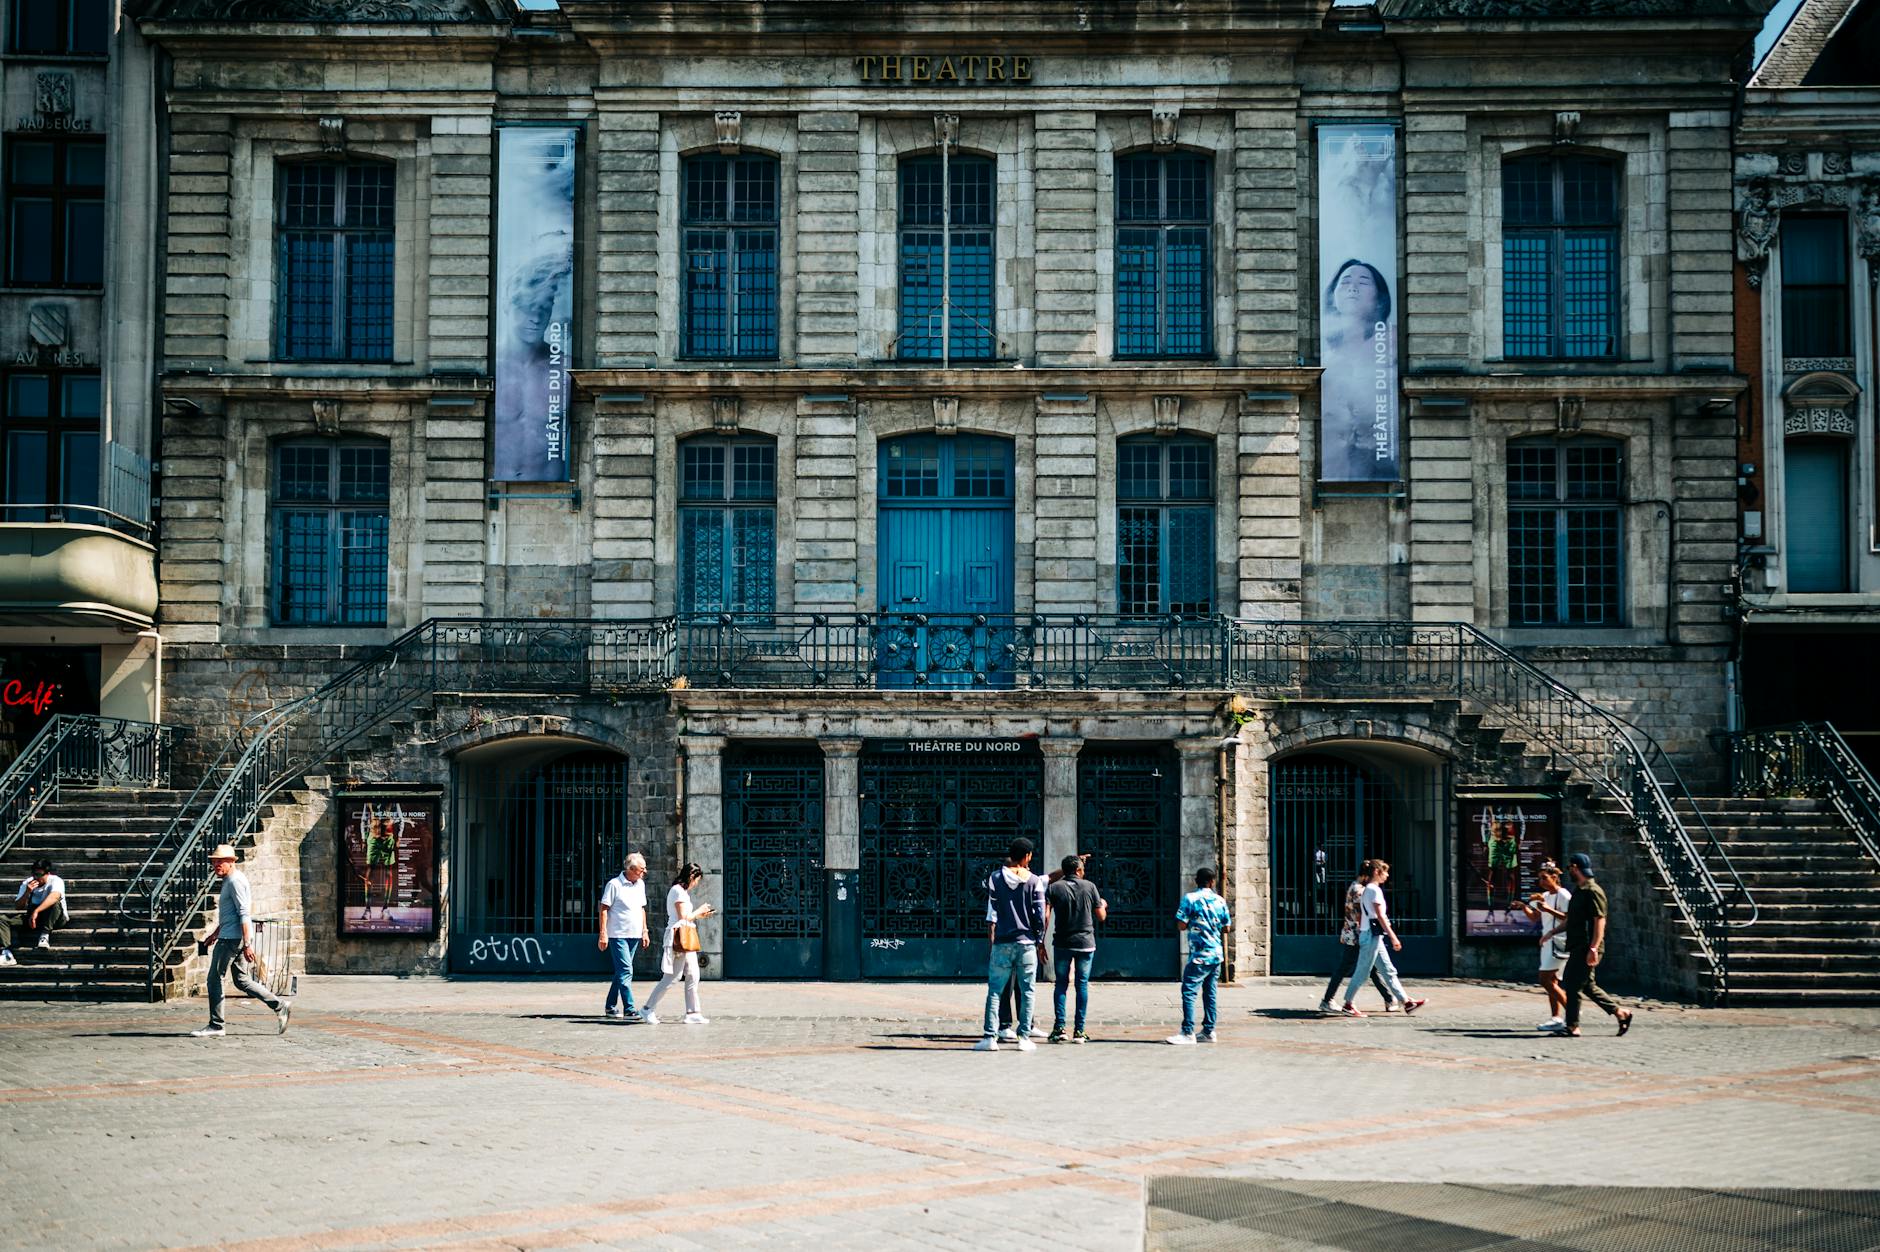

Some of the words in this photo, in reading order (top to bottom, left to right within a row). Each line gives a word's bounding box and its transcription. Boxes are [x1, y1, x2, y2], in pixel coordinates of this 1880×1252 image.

[855, 55, 1032, 80] THEATRE
[16, 118, 91, 130] MAUBEUGE
[549, 321, 562, 365] NORD
[1375, 320, 1387, 364] NORD
[16, 351, 81, 365] AVNES
[549, 369, 561, 390] DU
[1375, 369, 1387, 389] DU
[545, 394, 560, 461] THÉÂTRE
[1373, 394, 1388, 461] THÉÂTRE
[3, 679, 56, 716] Café
[908, 739, 962, 752] THÉÂTRE
[965, 742, 982, 752] DU
[986, 742, 1021, 752] NORD
